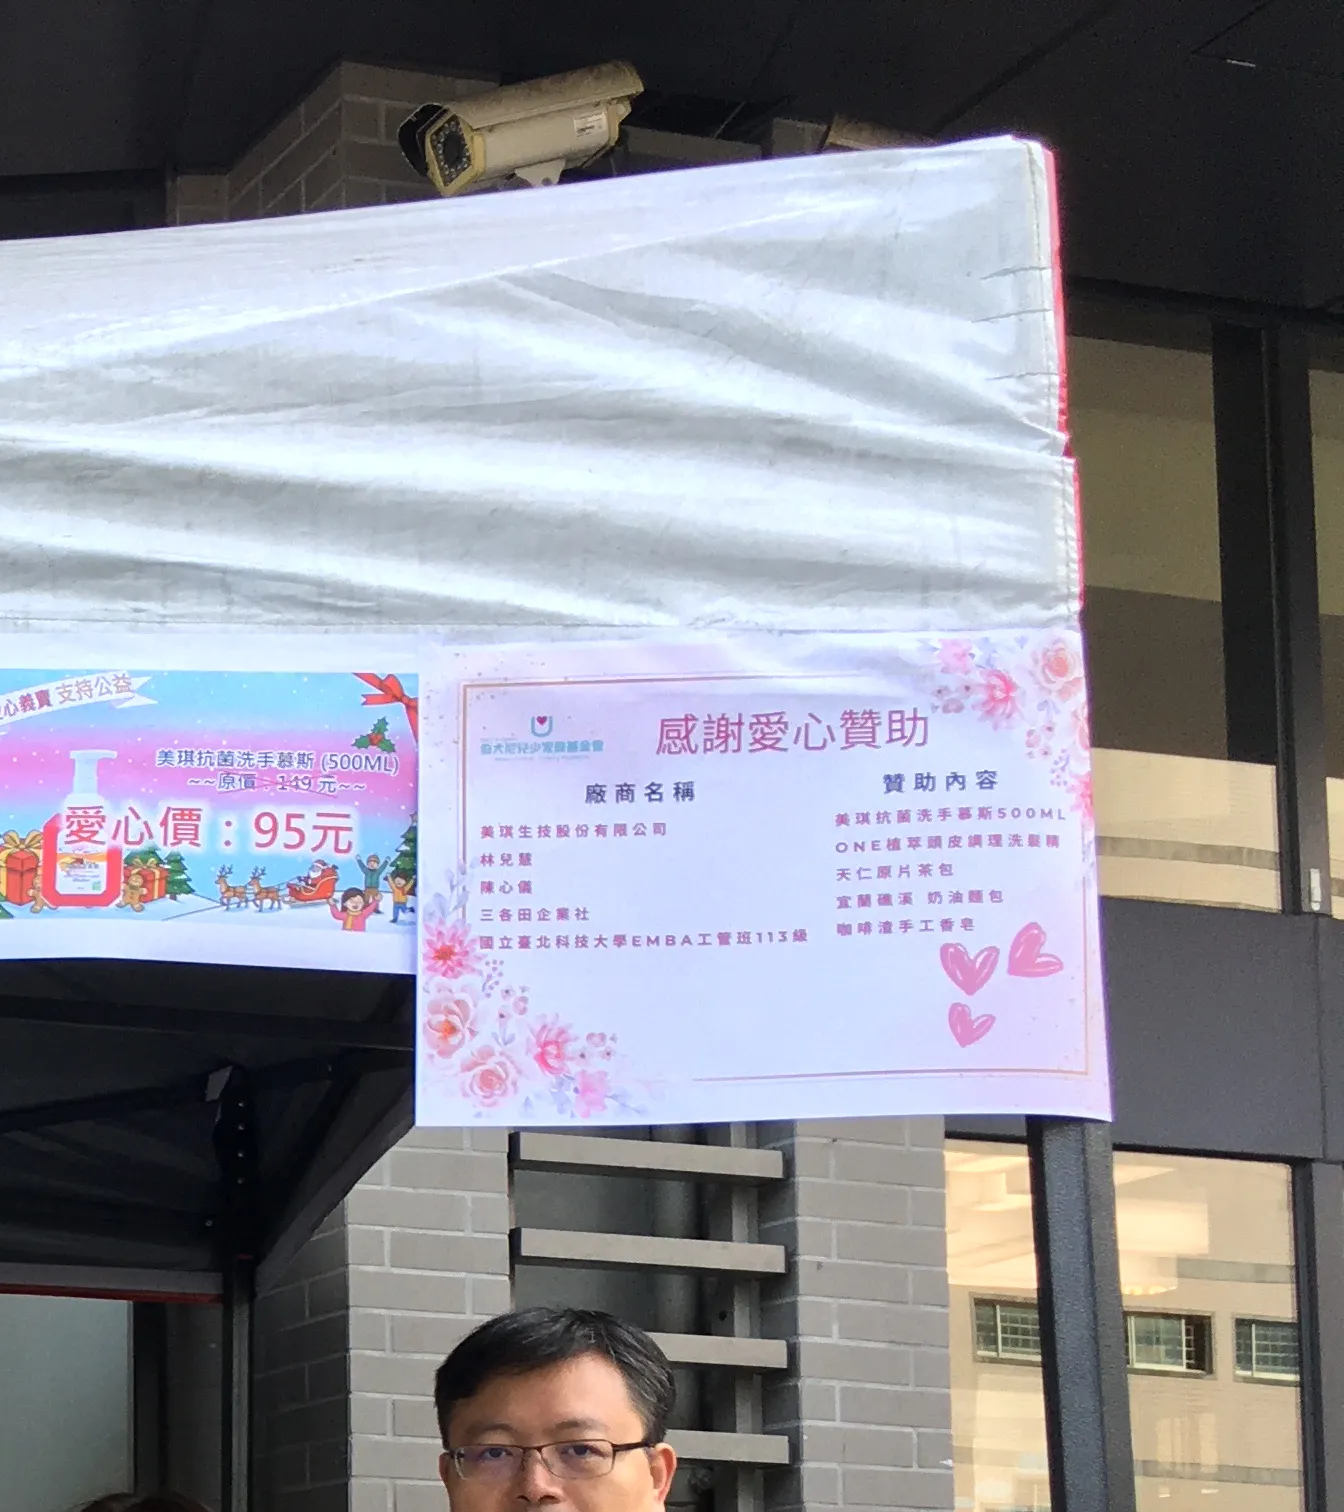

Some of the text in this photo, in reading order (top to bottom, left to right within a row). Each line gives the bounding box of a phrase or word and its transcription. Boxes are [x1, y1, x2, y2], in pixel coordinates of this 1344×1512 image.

[56, 673, 134, 705] 支持公益
[656, 707, 930, 755] 感謝愛心贊助
[156, 749, 399, 775] 美琪抗菌洗手慕斯 (500ML)
[585, 780, 697, 804] 廠商名稱
[883, 769, 999, 794] 贊助內容
[835, 805, 1067, 827] 美琪抗菌洗手慕斯500ML
[480, 822, 667, 839] 美琪生技股份有限公司
[836, 863, 954, 882] 天仁原片茶包
[836, 889, 1004, 910] 宜蘭礁溪 奶油麵包
[836, 917, 975, 937] 咖啡渣手工香皂
